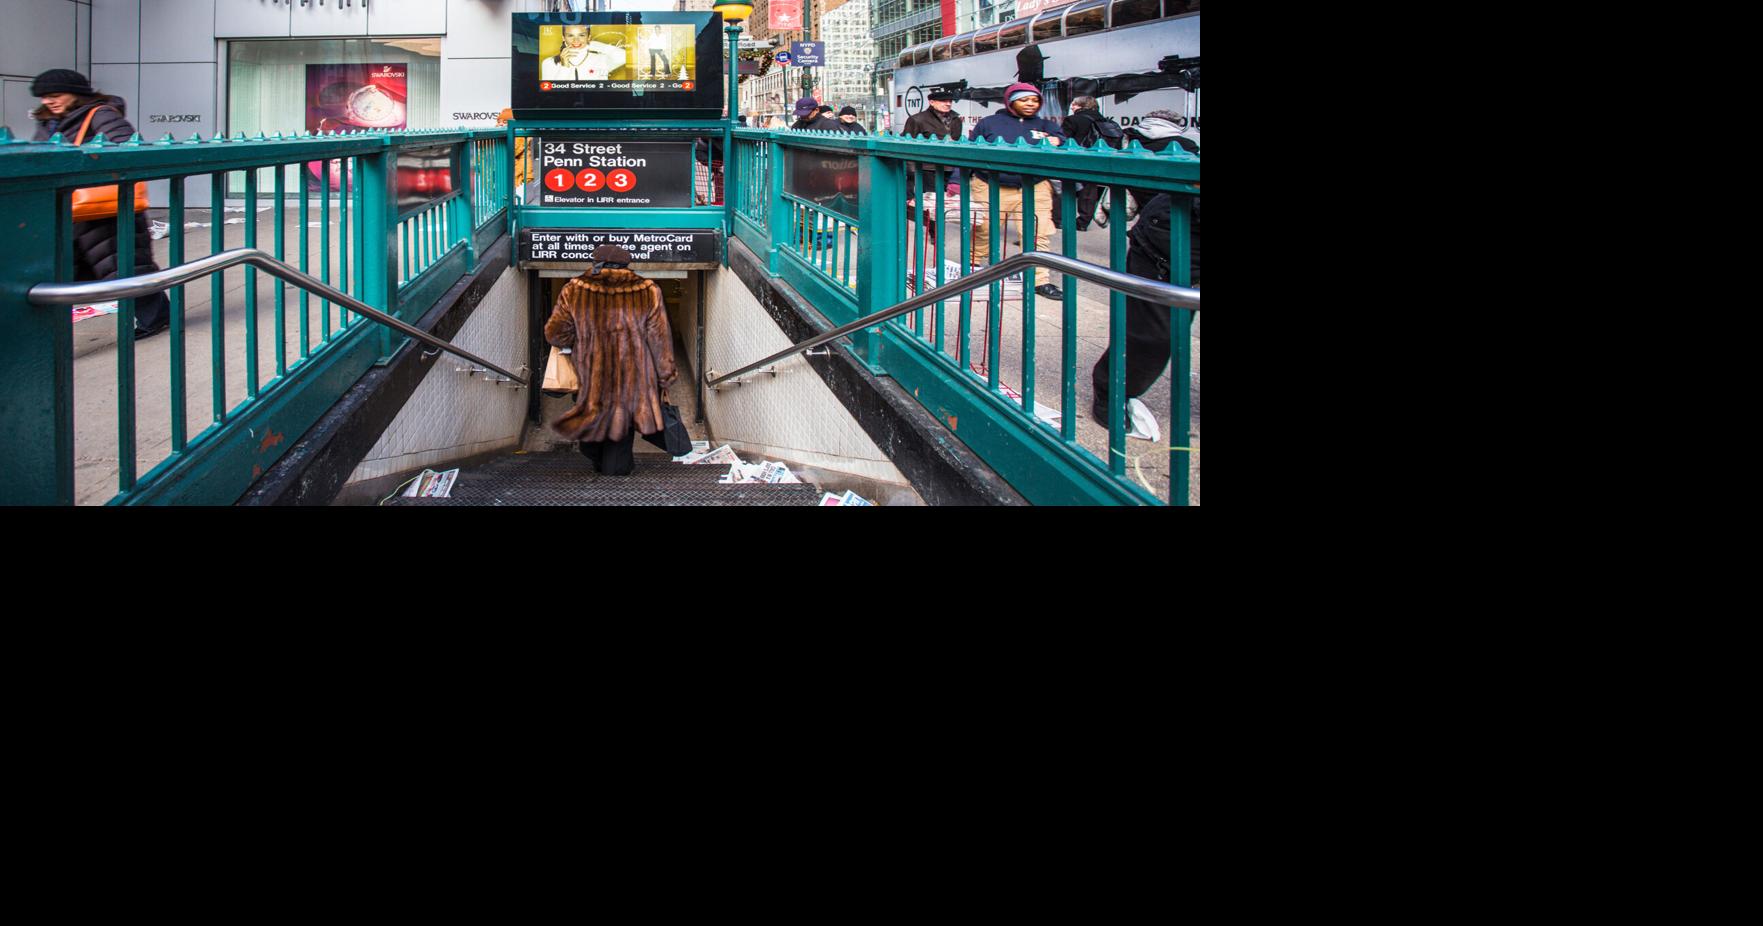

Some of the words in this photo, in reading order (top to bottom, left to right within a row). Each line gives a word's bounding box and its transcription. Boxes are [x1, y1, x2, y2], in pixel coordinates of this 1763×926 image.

[907, 99, 921, 108] TNT
[452, 111, 501, 121] SWAROVS
[544, 143, 566, 155] 34
[572, 143, 622, 155] Street
[544, 156, 583, 167] Penn
[589, 156, 647, 168] Station
[554, 196, 585, 204] Elevator
[531, 233, 561, 242] Enter
[565, 233, 589, 242] with
[608, 234, 630, 244] buy
[633, 234, 693, 243] MetroCard
[547, 242, 560, 250] all
[563, 242, 595, 251] times
[640, 243, 673, 253] agent
[531, 250, 558, 259] LIRR
